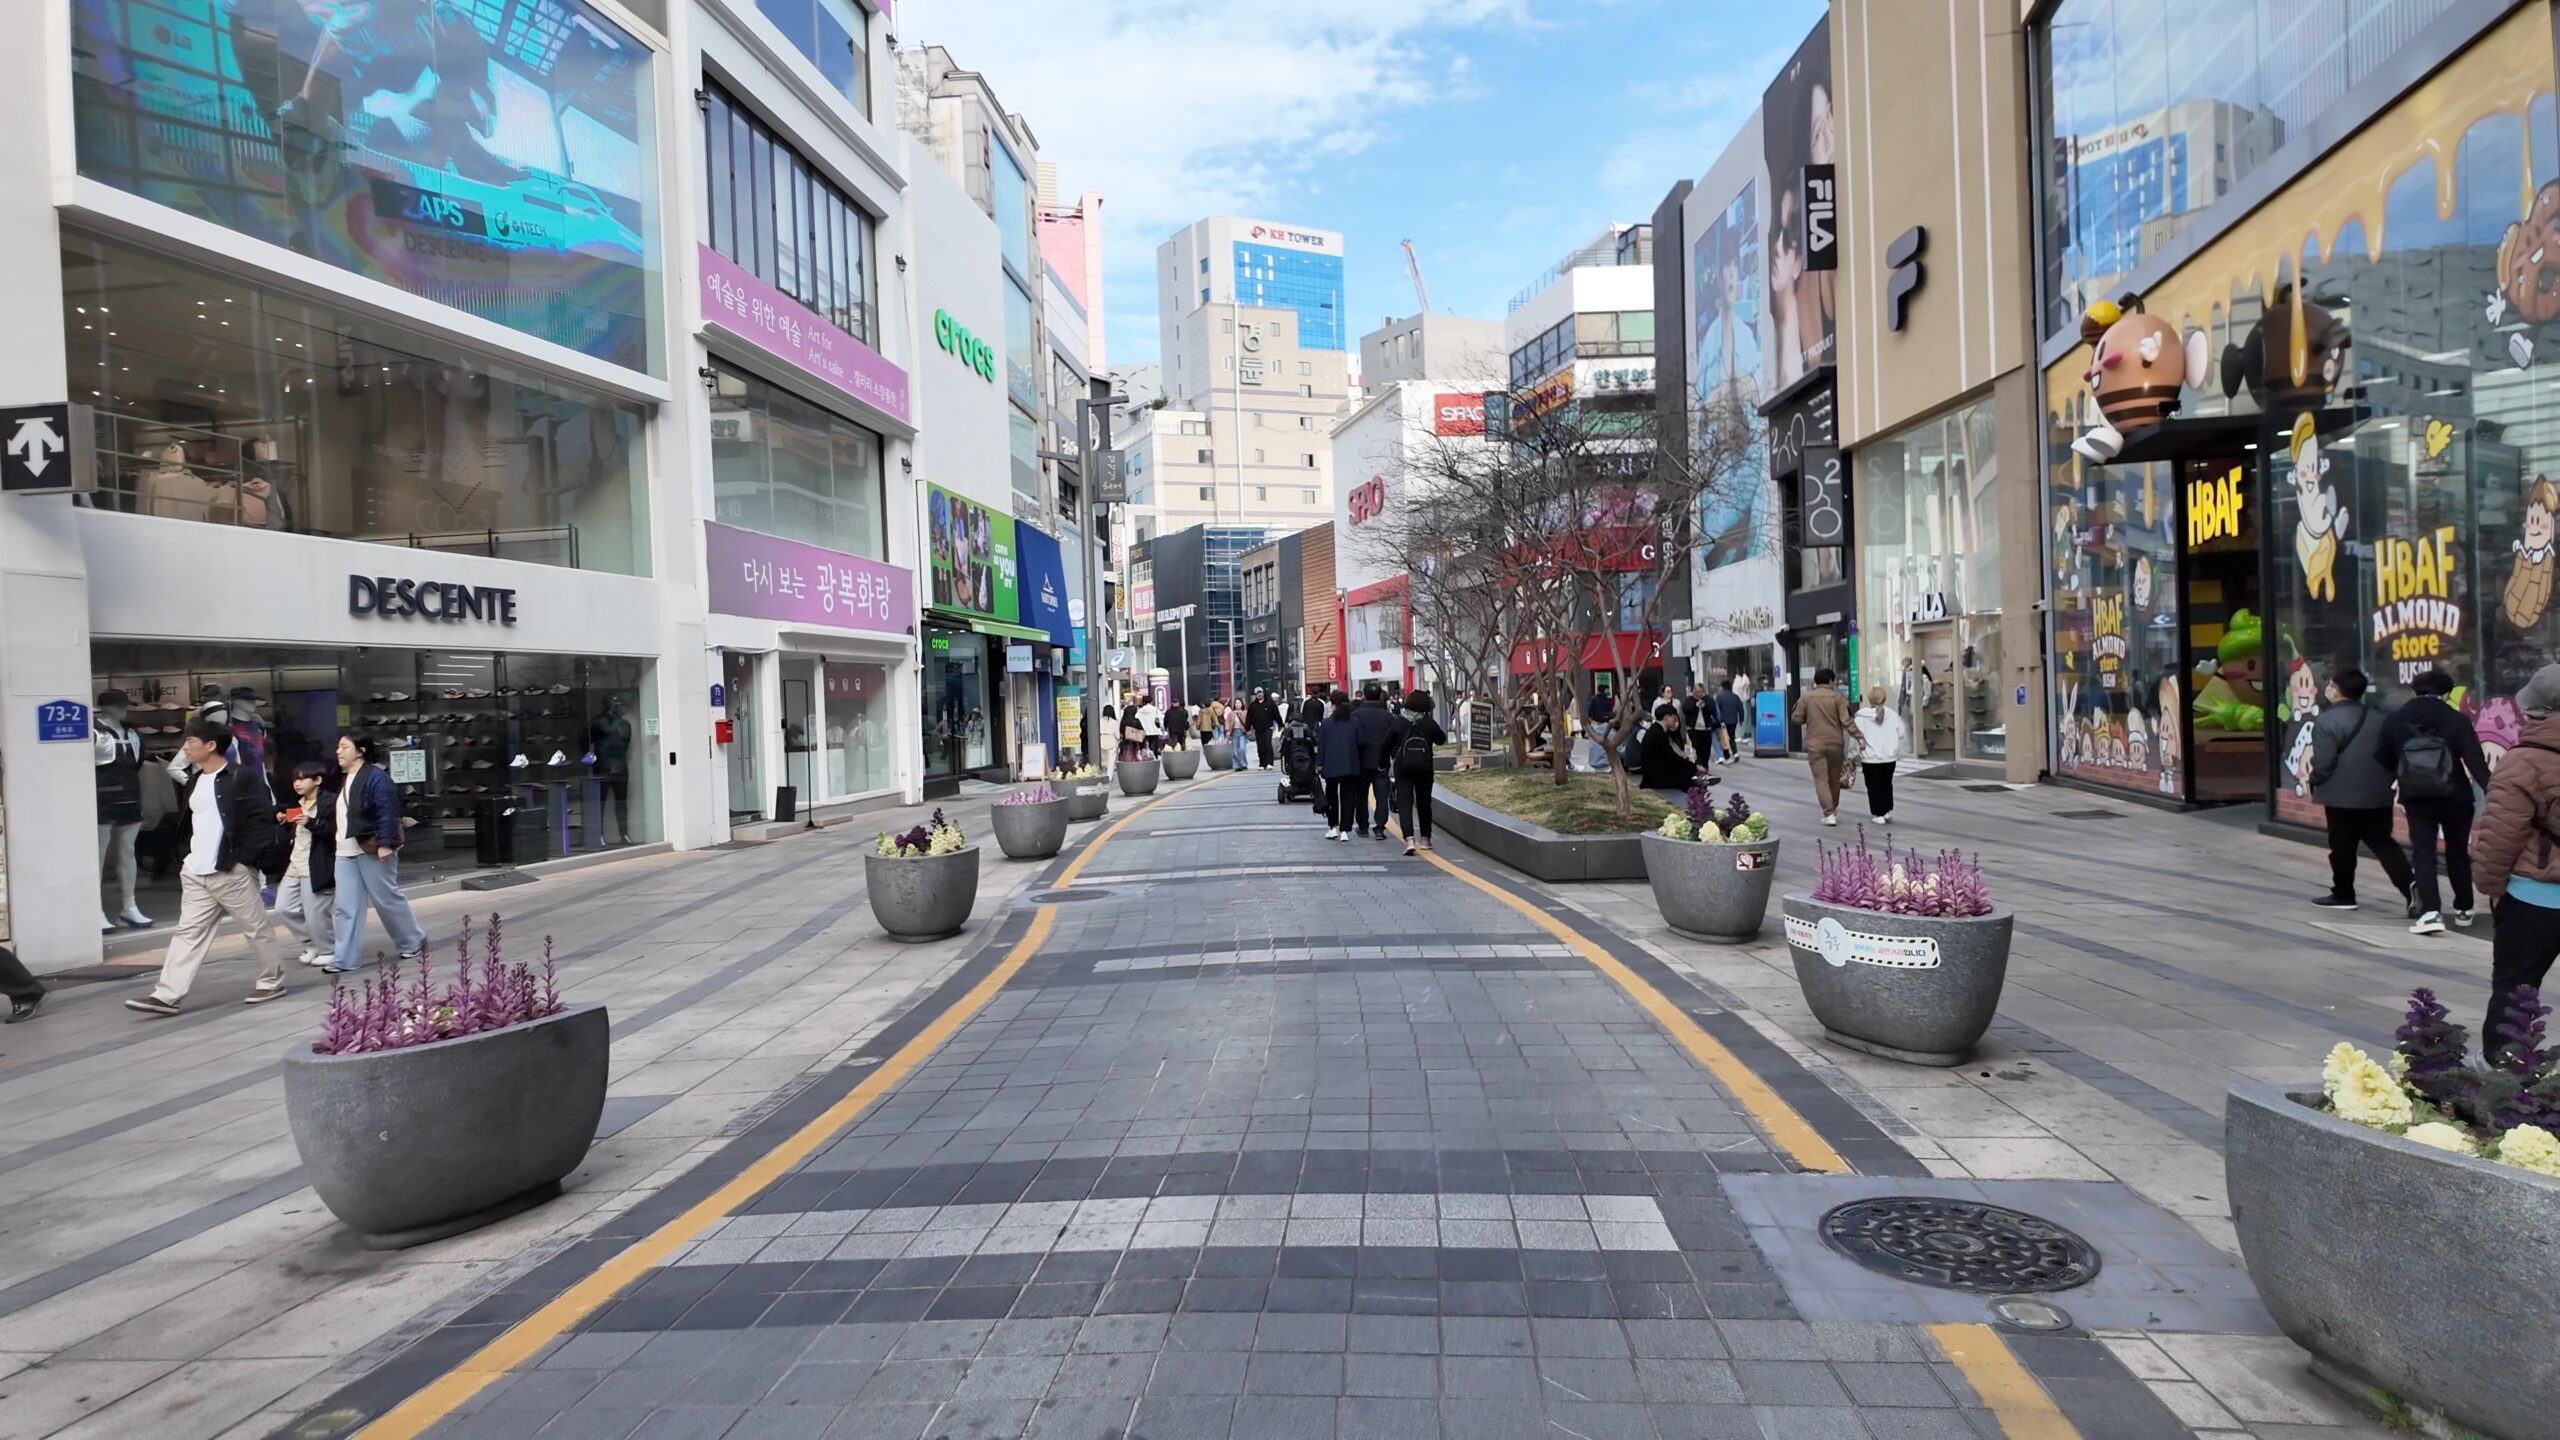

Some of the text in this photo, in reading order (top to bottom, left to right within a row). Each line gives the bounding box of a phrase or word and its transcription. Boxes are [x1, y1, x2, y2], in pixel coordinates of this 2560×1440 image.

[1808, 179, 1835, 252] FILA
[1269, 229, 1324, 247] KH TOWER
[707, 273, 802, 348] 예술을 위한 예술
[808, 325, 832, 351] Art for
[934, 308, 996, 383] crocs
[828, 360, 844, 378] sake
[2188, 465, 2243, 548] HBAF
[1000, 556, 1015, 580] you
[2374, 525, 2456, 606] HBAF
[350, 574, 517, 623] DESCENTE
[743, 559, 892, 621] 다시 보는 광복화랑
[1909, 591, 1947, 620] FILA
[2093, 592, 2123, 639] HBAF
[2372, 598, 2460, 643] ALMOND
[931, 638, 949, 650] crocs
[2093, 634, 2126, 661] ALMOND
[2392, 633, 2439, 661] store
[2100, 655, 2118, 673] store
[46, 706, 81, 721] 73-2
